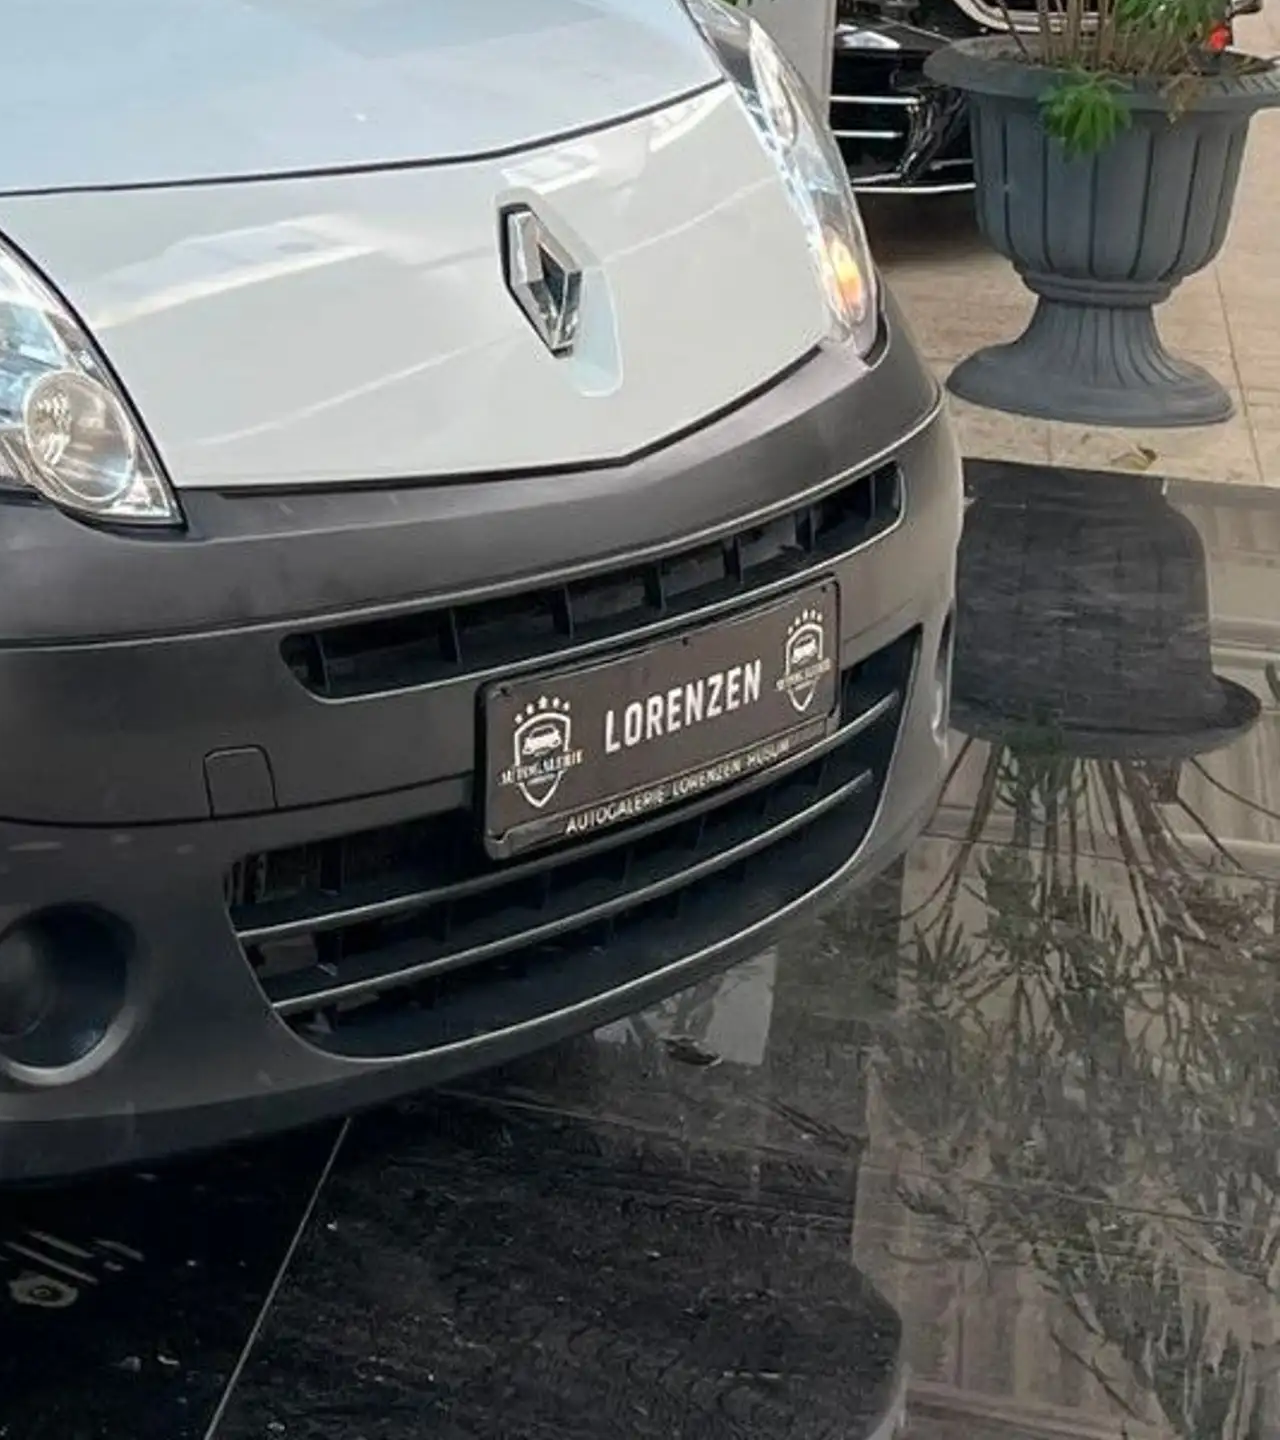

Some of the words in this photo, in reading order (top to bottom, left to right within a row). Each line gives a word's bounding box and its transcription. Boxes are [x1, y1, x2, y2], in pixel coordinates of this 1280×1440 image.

[604, 659, 762, 755] LORENZEN
[564, 784, 666, 836] AUTOGALERIE
[671, 759, 742, 798] LORENZEN
